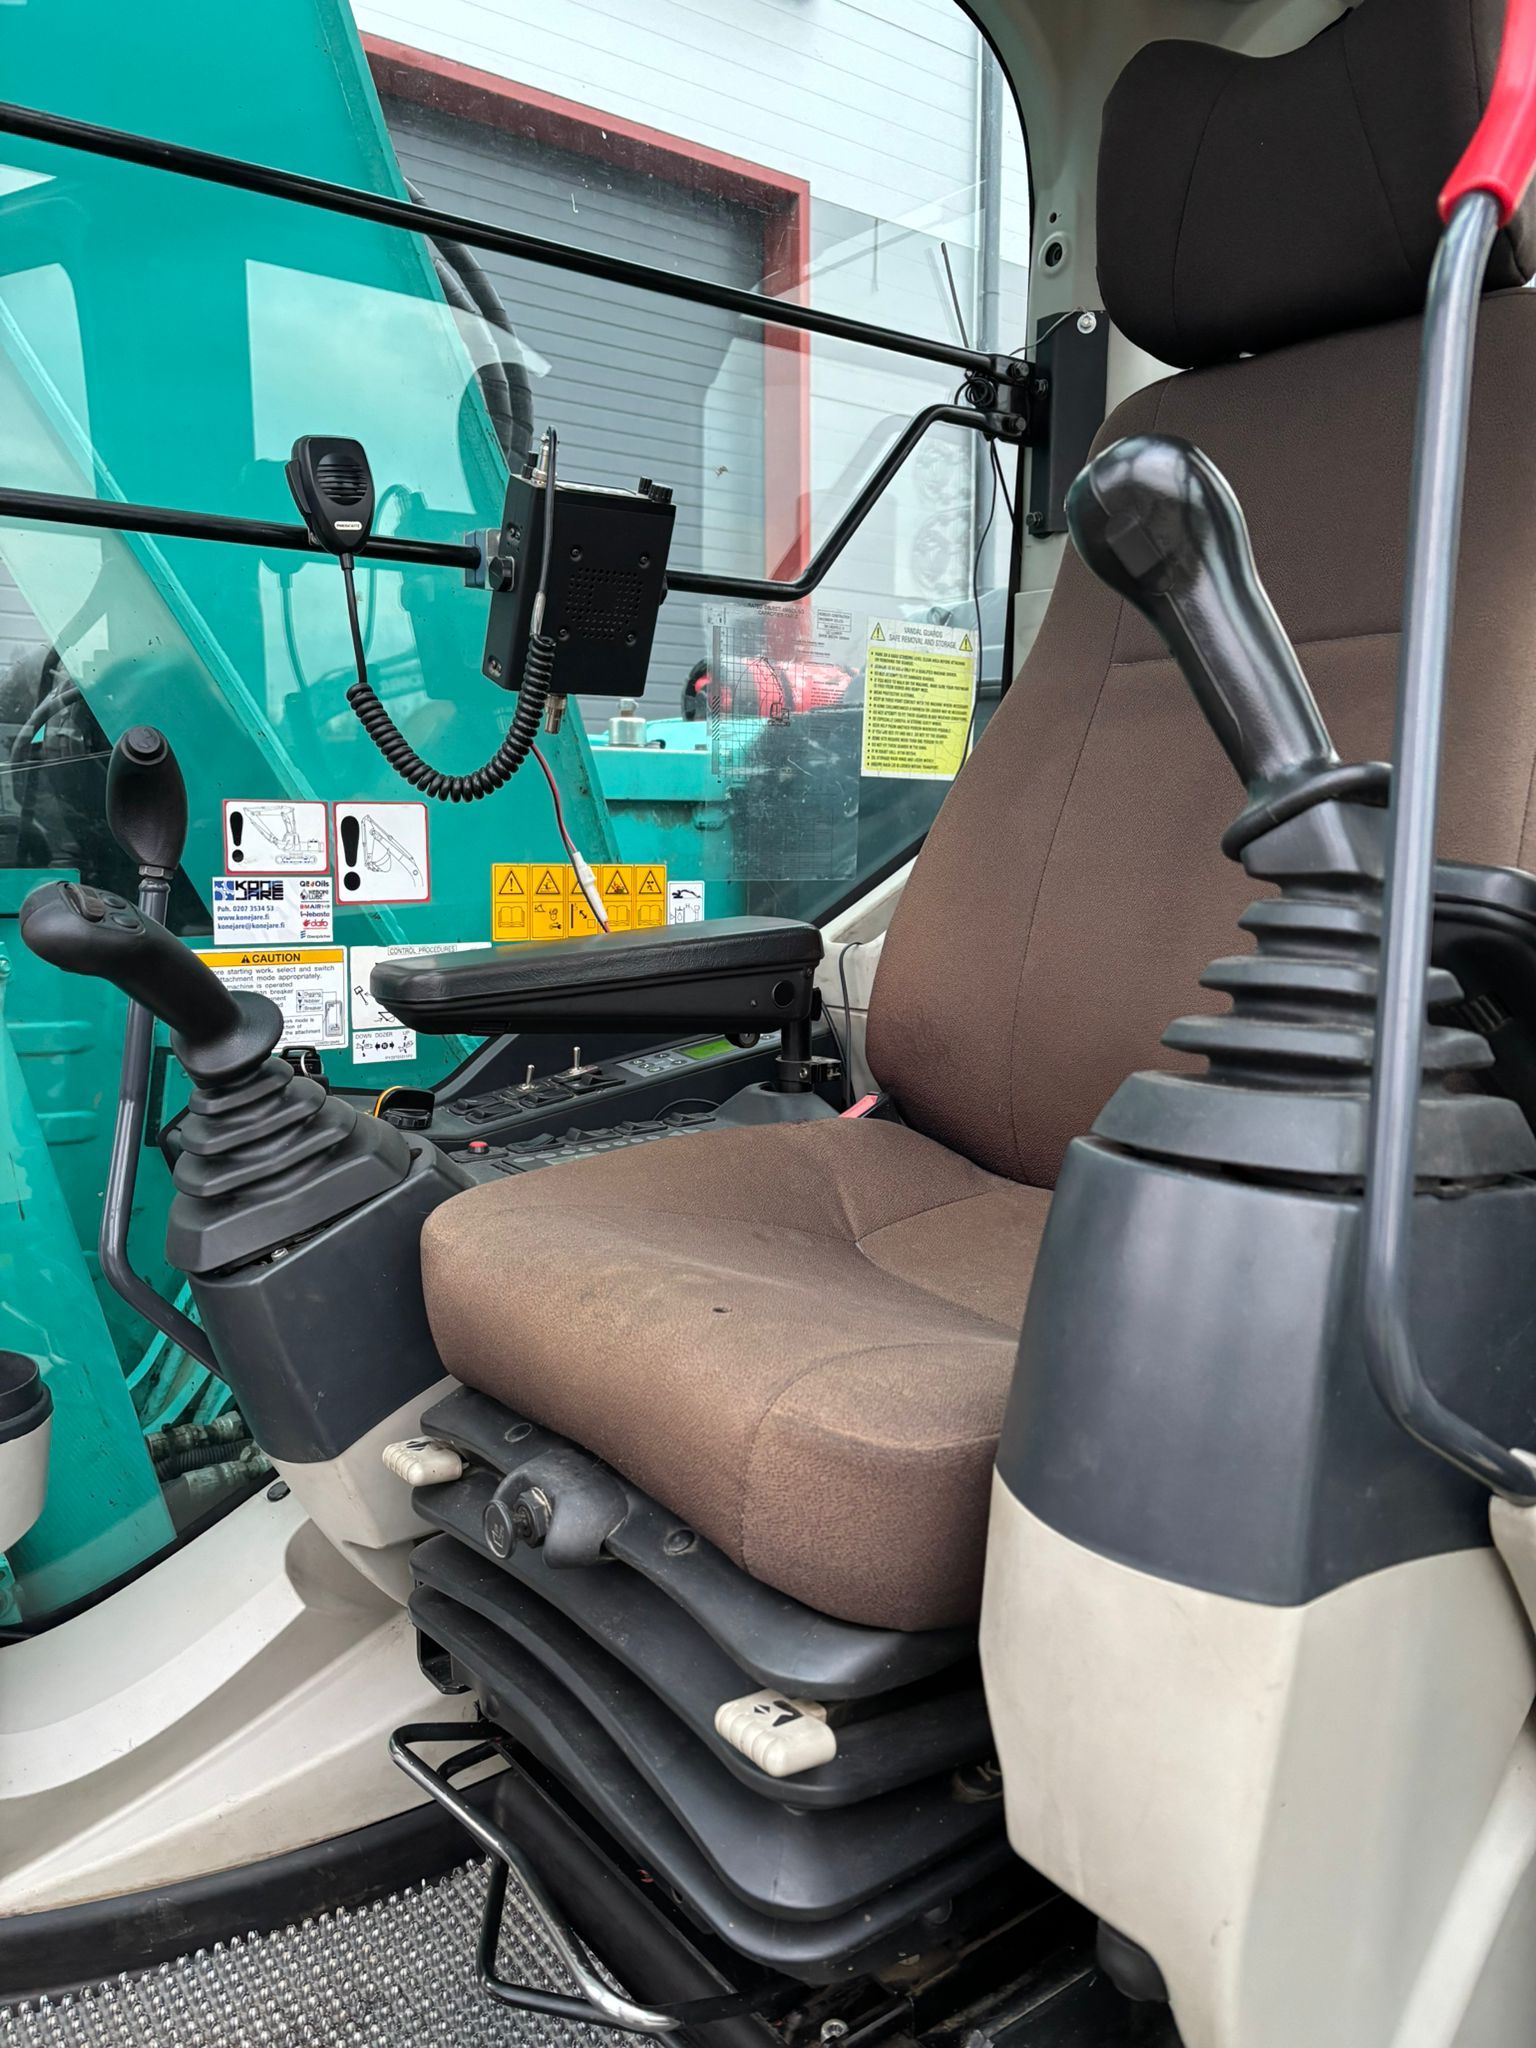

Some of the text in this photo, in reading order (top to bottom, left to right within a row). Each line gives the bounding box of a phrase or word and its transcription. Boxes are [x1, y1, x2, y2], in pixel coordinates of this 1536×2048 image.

[904, 627, 943, 638] VANDAL GUARDS
[889, 634, 901, 642] SAFE
[901, 635, 923, 645] REMOVAL
[924, 637, 935, 646] AND
[235, 890, 284, 901] JARE
[217, 914, 270, 922] www.konejare.fi
[217, 922, 285, 931] konejare@konejare.fi
[389, 947, 416, 955] CONTROL
[252, 953, 301, 963] CAUTION
[227, 968, 253, 976] starting
[256, 974, 276, 982] mode
[278, 973, 321, 982] appropriately.
